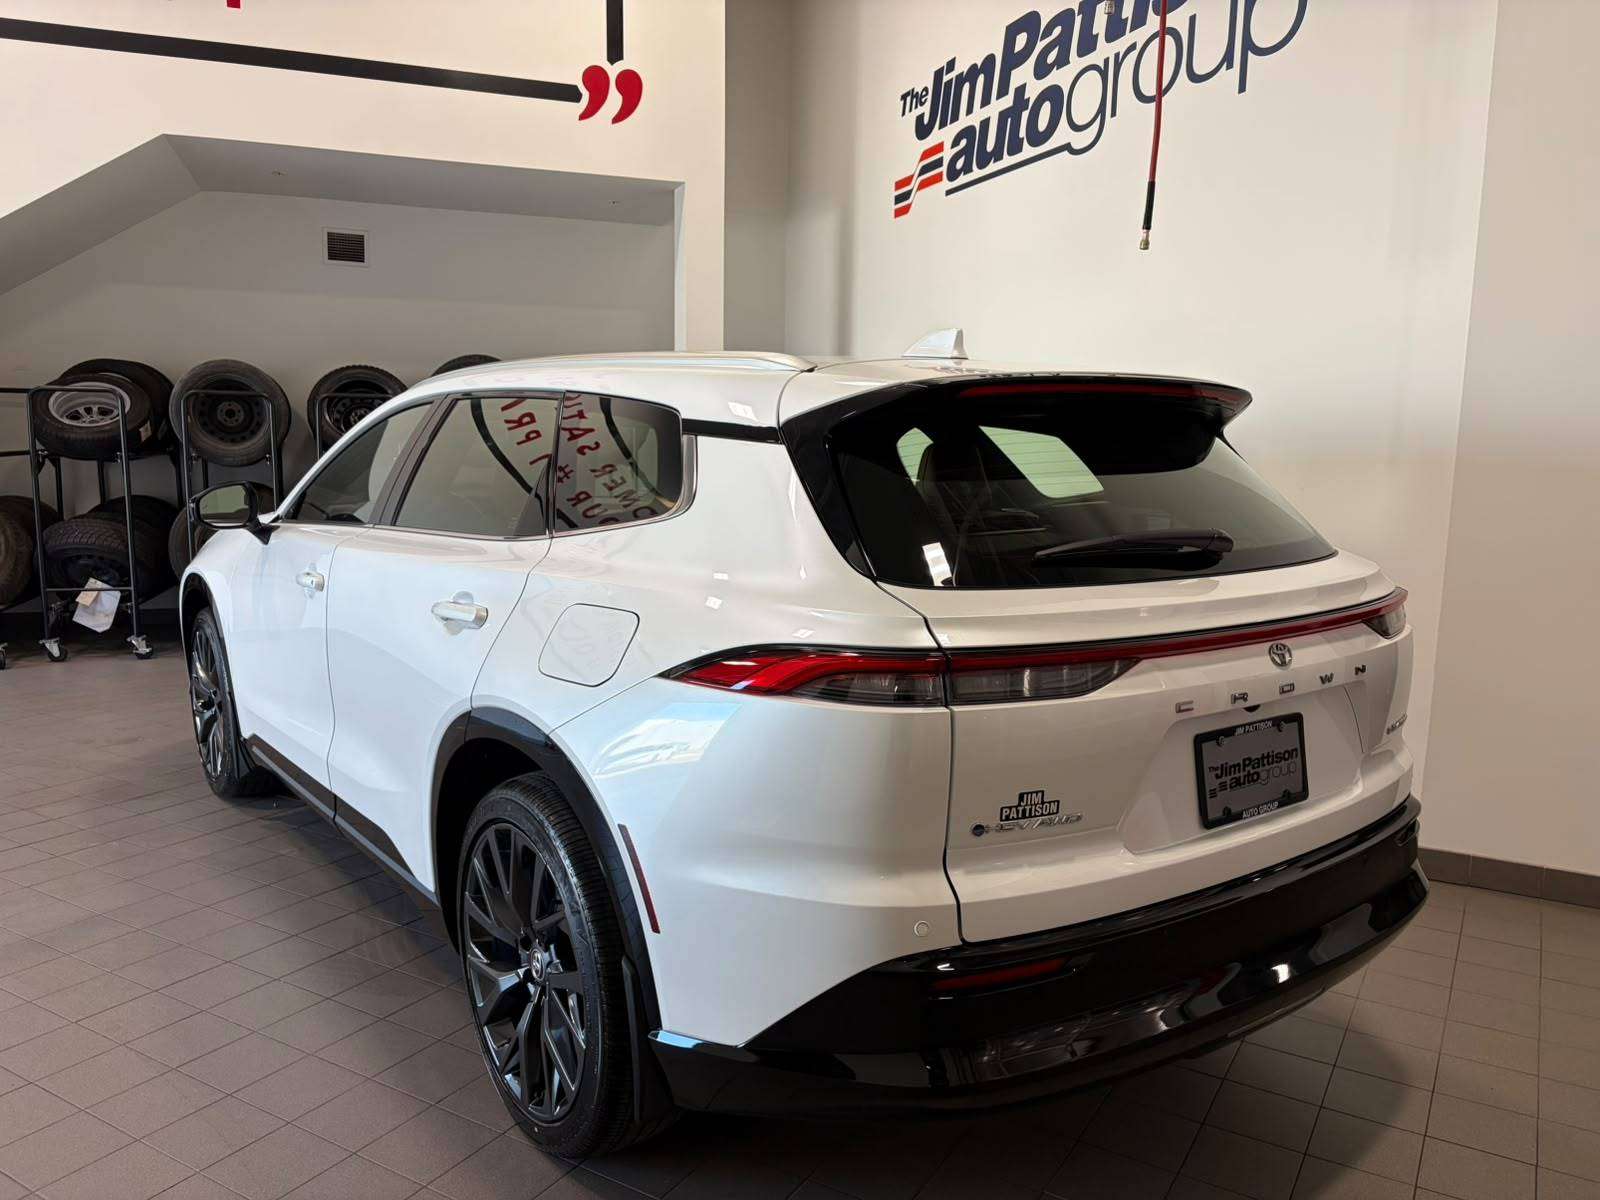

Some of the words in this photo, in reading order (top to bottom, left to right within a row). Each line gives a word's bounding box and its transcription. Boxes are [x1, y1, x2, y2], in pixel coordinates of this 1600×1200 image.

[900, 86, 930, 117] The
[1175, 664, 1367, 714] CROWN
[1246, 720, 1273, 734] PATTISON
[1020, 792, 1043, 806] JIM
[1002, 801, 1058, 820] PATTISON
[1242, 806, 1258, 818] AUTO
[1259, 801, 1279, 814] GROUP
